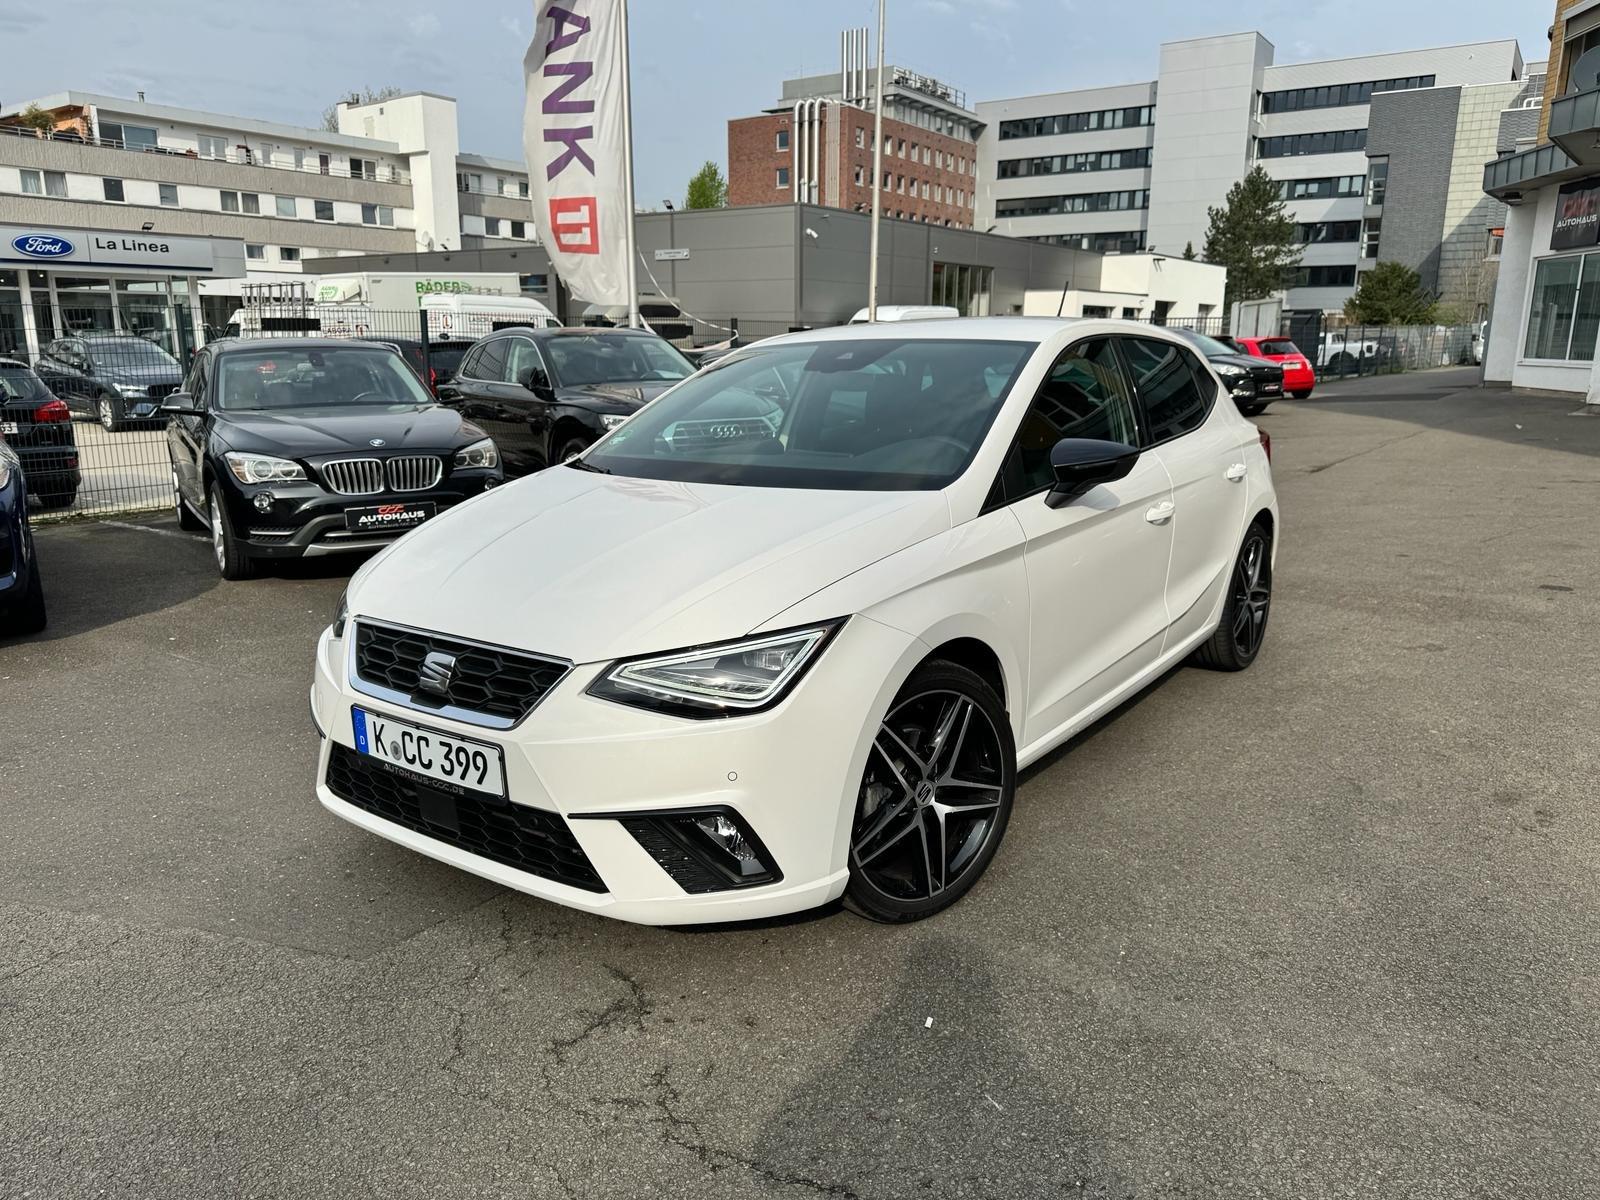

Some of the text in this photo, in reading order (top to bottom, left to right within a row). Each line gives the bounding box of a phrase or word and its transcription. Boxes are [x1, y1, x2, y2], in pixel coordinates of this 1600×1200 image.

[1556, 214, 1597, 228] AUTOHAUS
[25, 237, 62, 252] Ford
[95, 237, 169, 253] La Linea
[358, 510, 425, 523] AUTOHAUS
[372, 721, 488, 785] K CC 399
